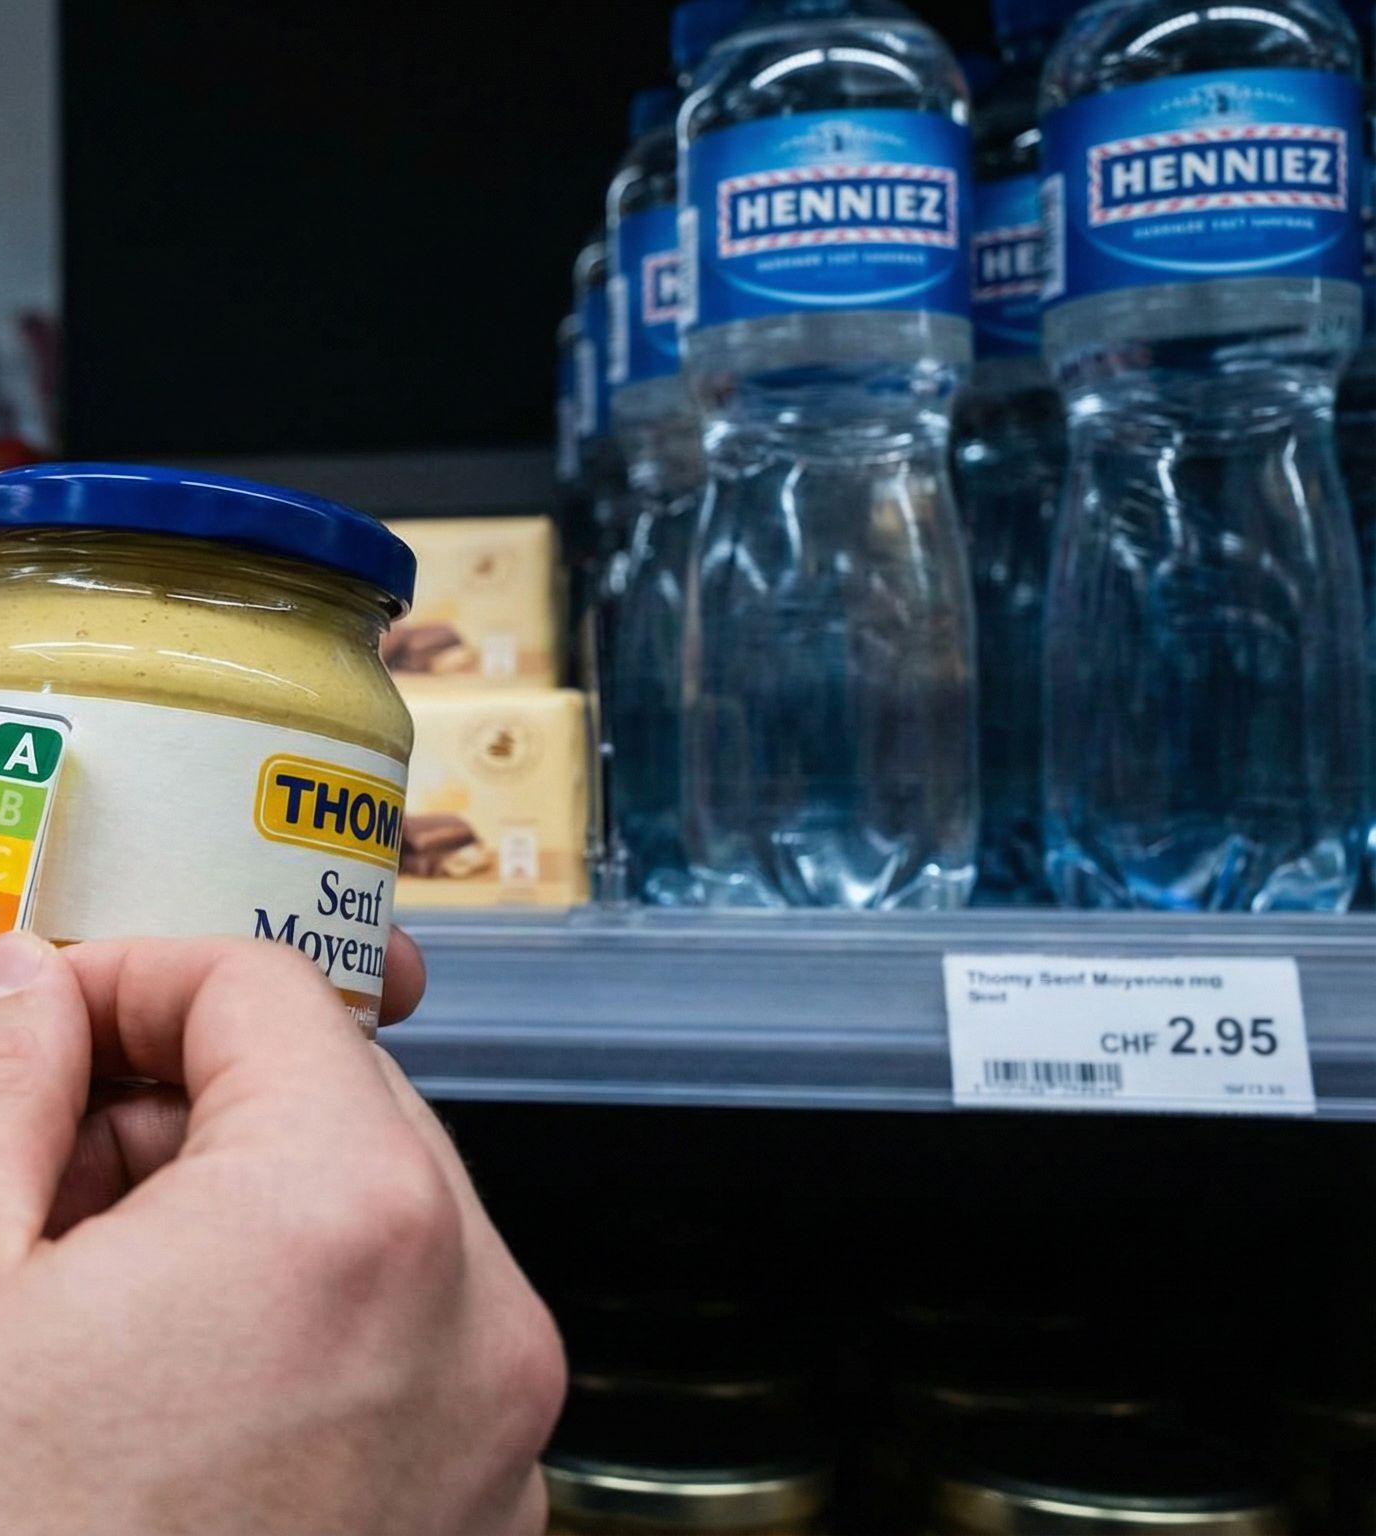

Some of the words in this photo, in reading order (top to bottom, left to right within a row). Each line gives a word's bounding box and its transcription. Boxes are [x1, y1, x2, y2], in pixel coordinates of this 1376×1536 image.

[1111, 146, 1333, 199] HENNIEZ
[736, 184, 944, 233] HENNIEZ
[3, 731, 39, 775] A
[276, 774, 403, 850] THOM
[317, 869, 385, 927] Senf
[253, 908, 384, 979] Moyenn
[1101, 1033, 1157, 1054] CHF
[1168, 1016, 1278, 1056] 2.95
